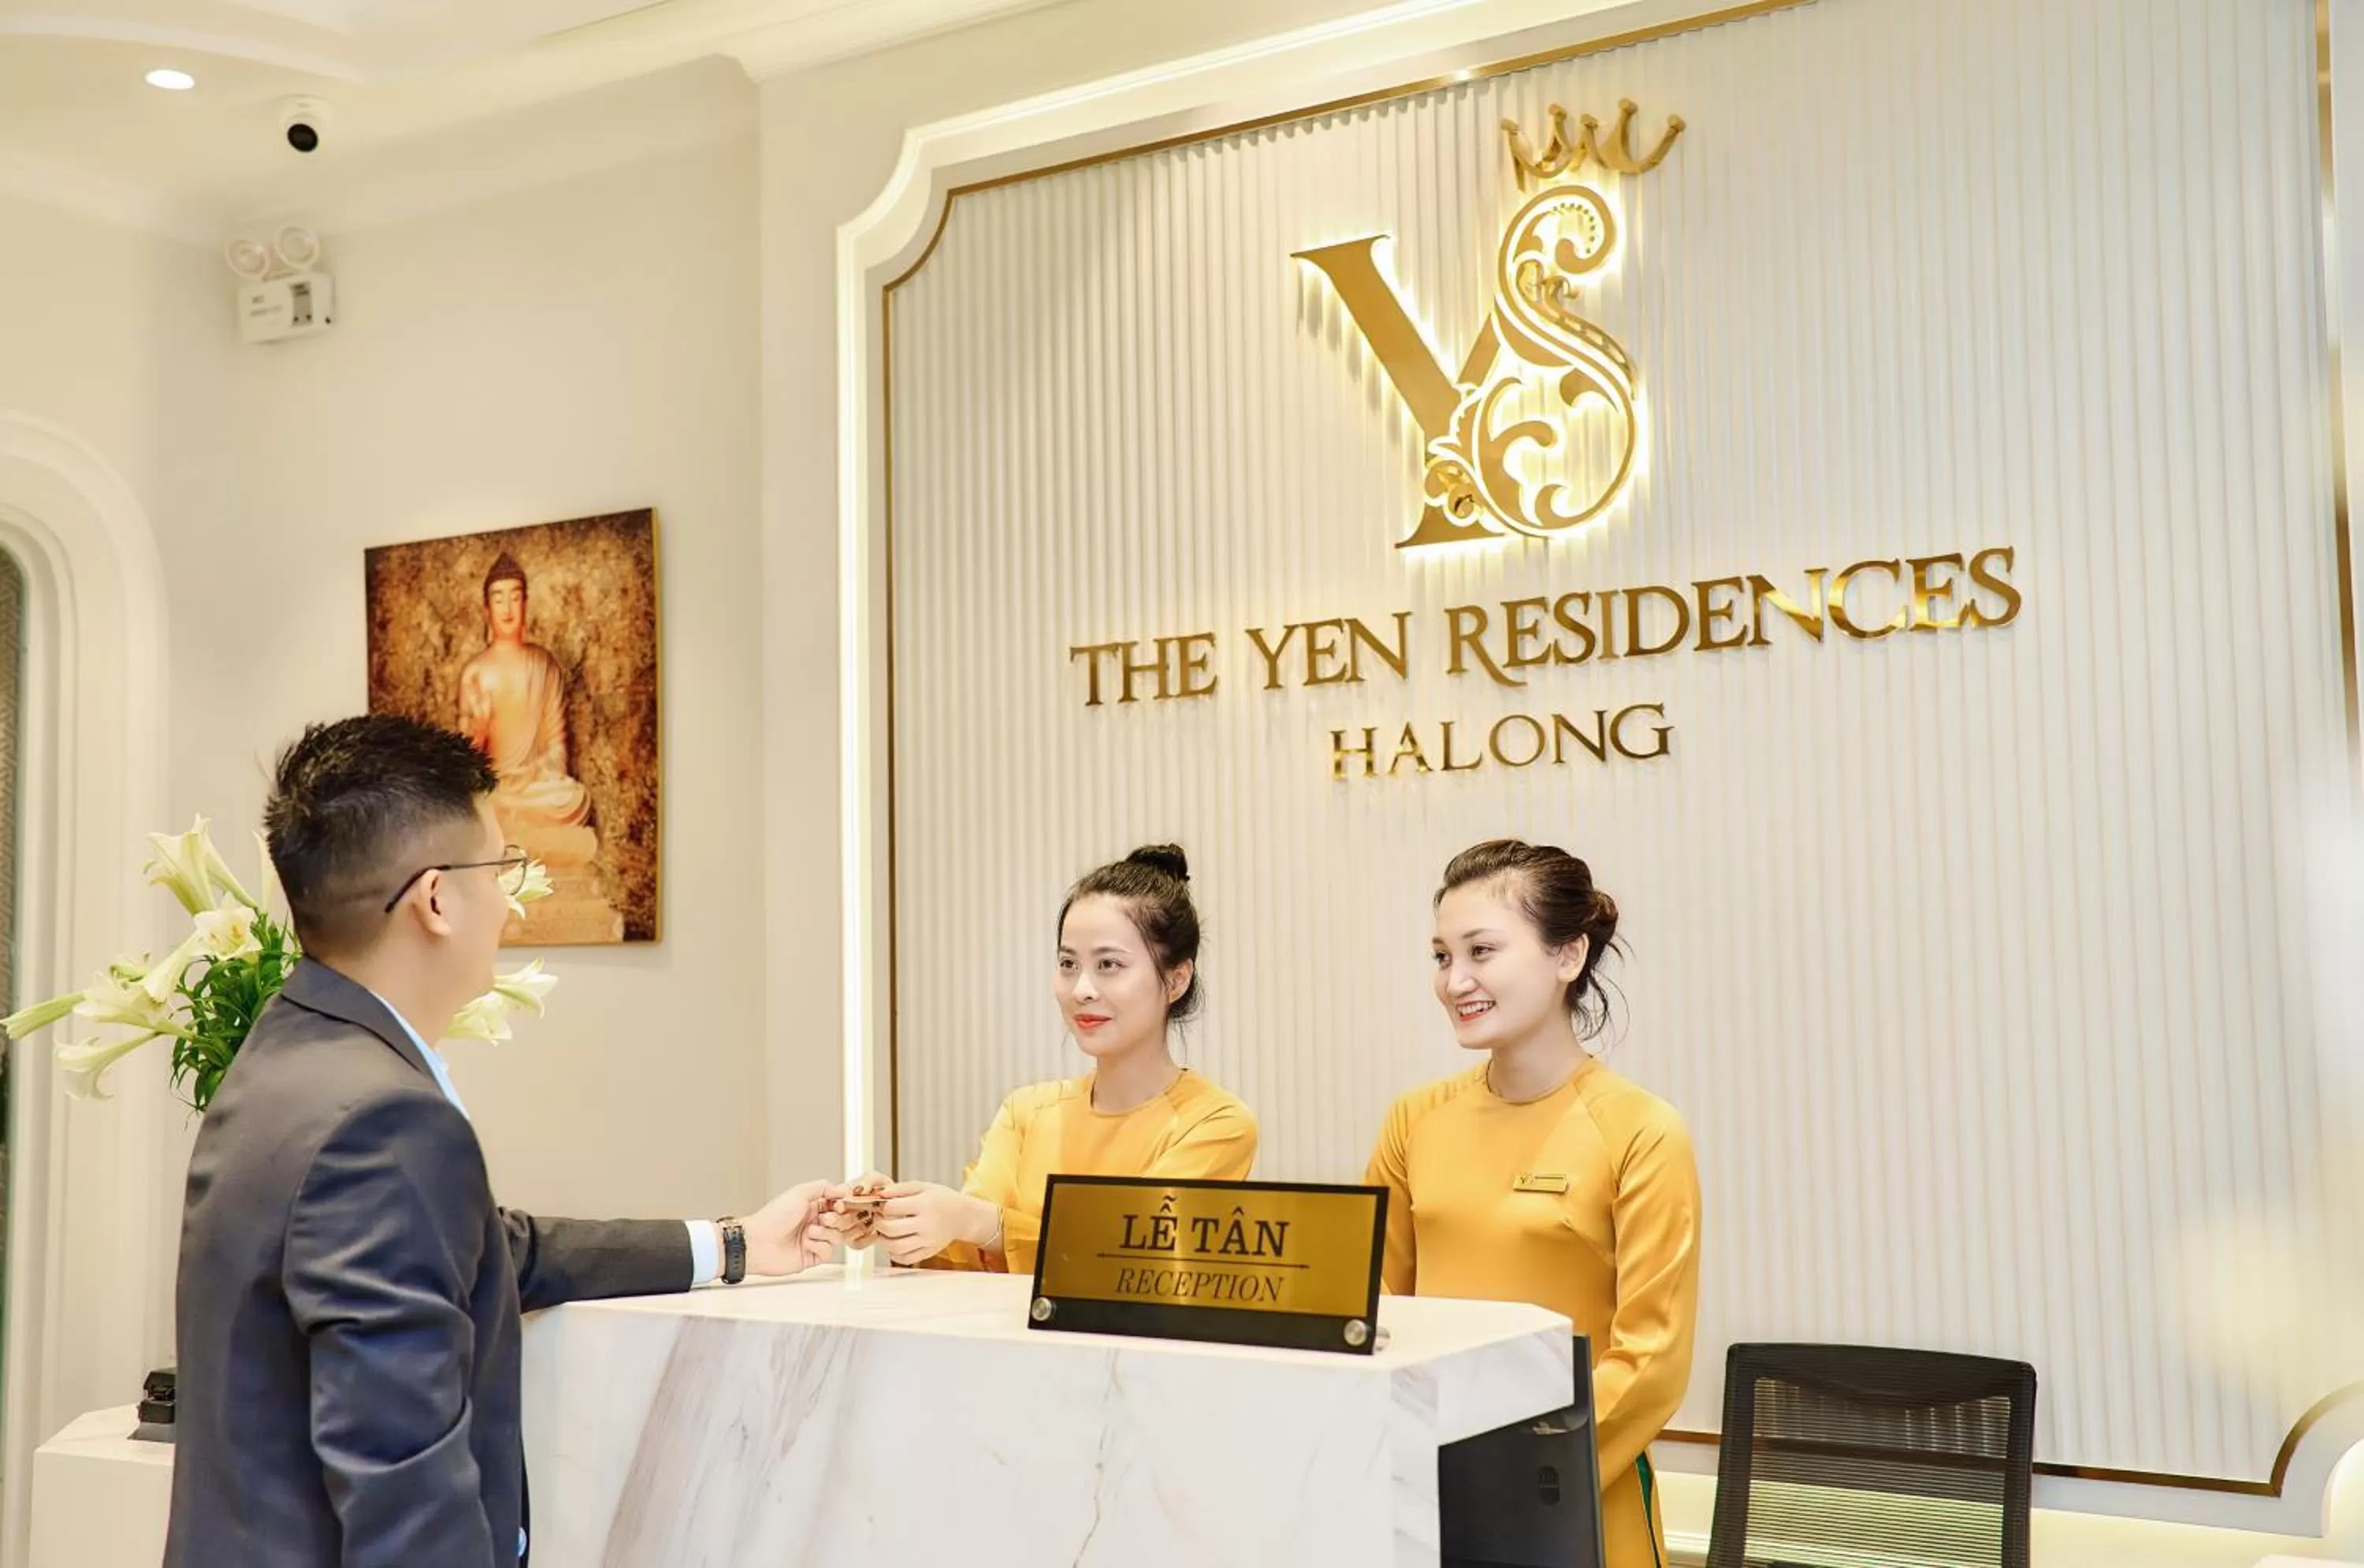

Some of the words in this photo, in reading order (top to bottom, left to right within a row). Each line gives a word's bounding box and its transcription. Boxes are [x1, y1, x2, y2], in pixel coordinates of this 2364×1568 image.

[1070, 633, 1218, 706] THE
[1243, 611, 1413, 691] YEN
[1445, 546, 2024, 686] RESIDENCES
[1329, 702, 1674, 780] HALONG
[1119, 1195, 1178, 1250] LỄ
[1191, 1206, 1290, 1257] TÂN
[1115, 1268, 1286, 1302] RECEPTION
